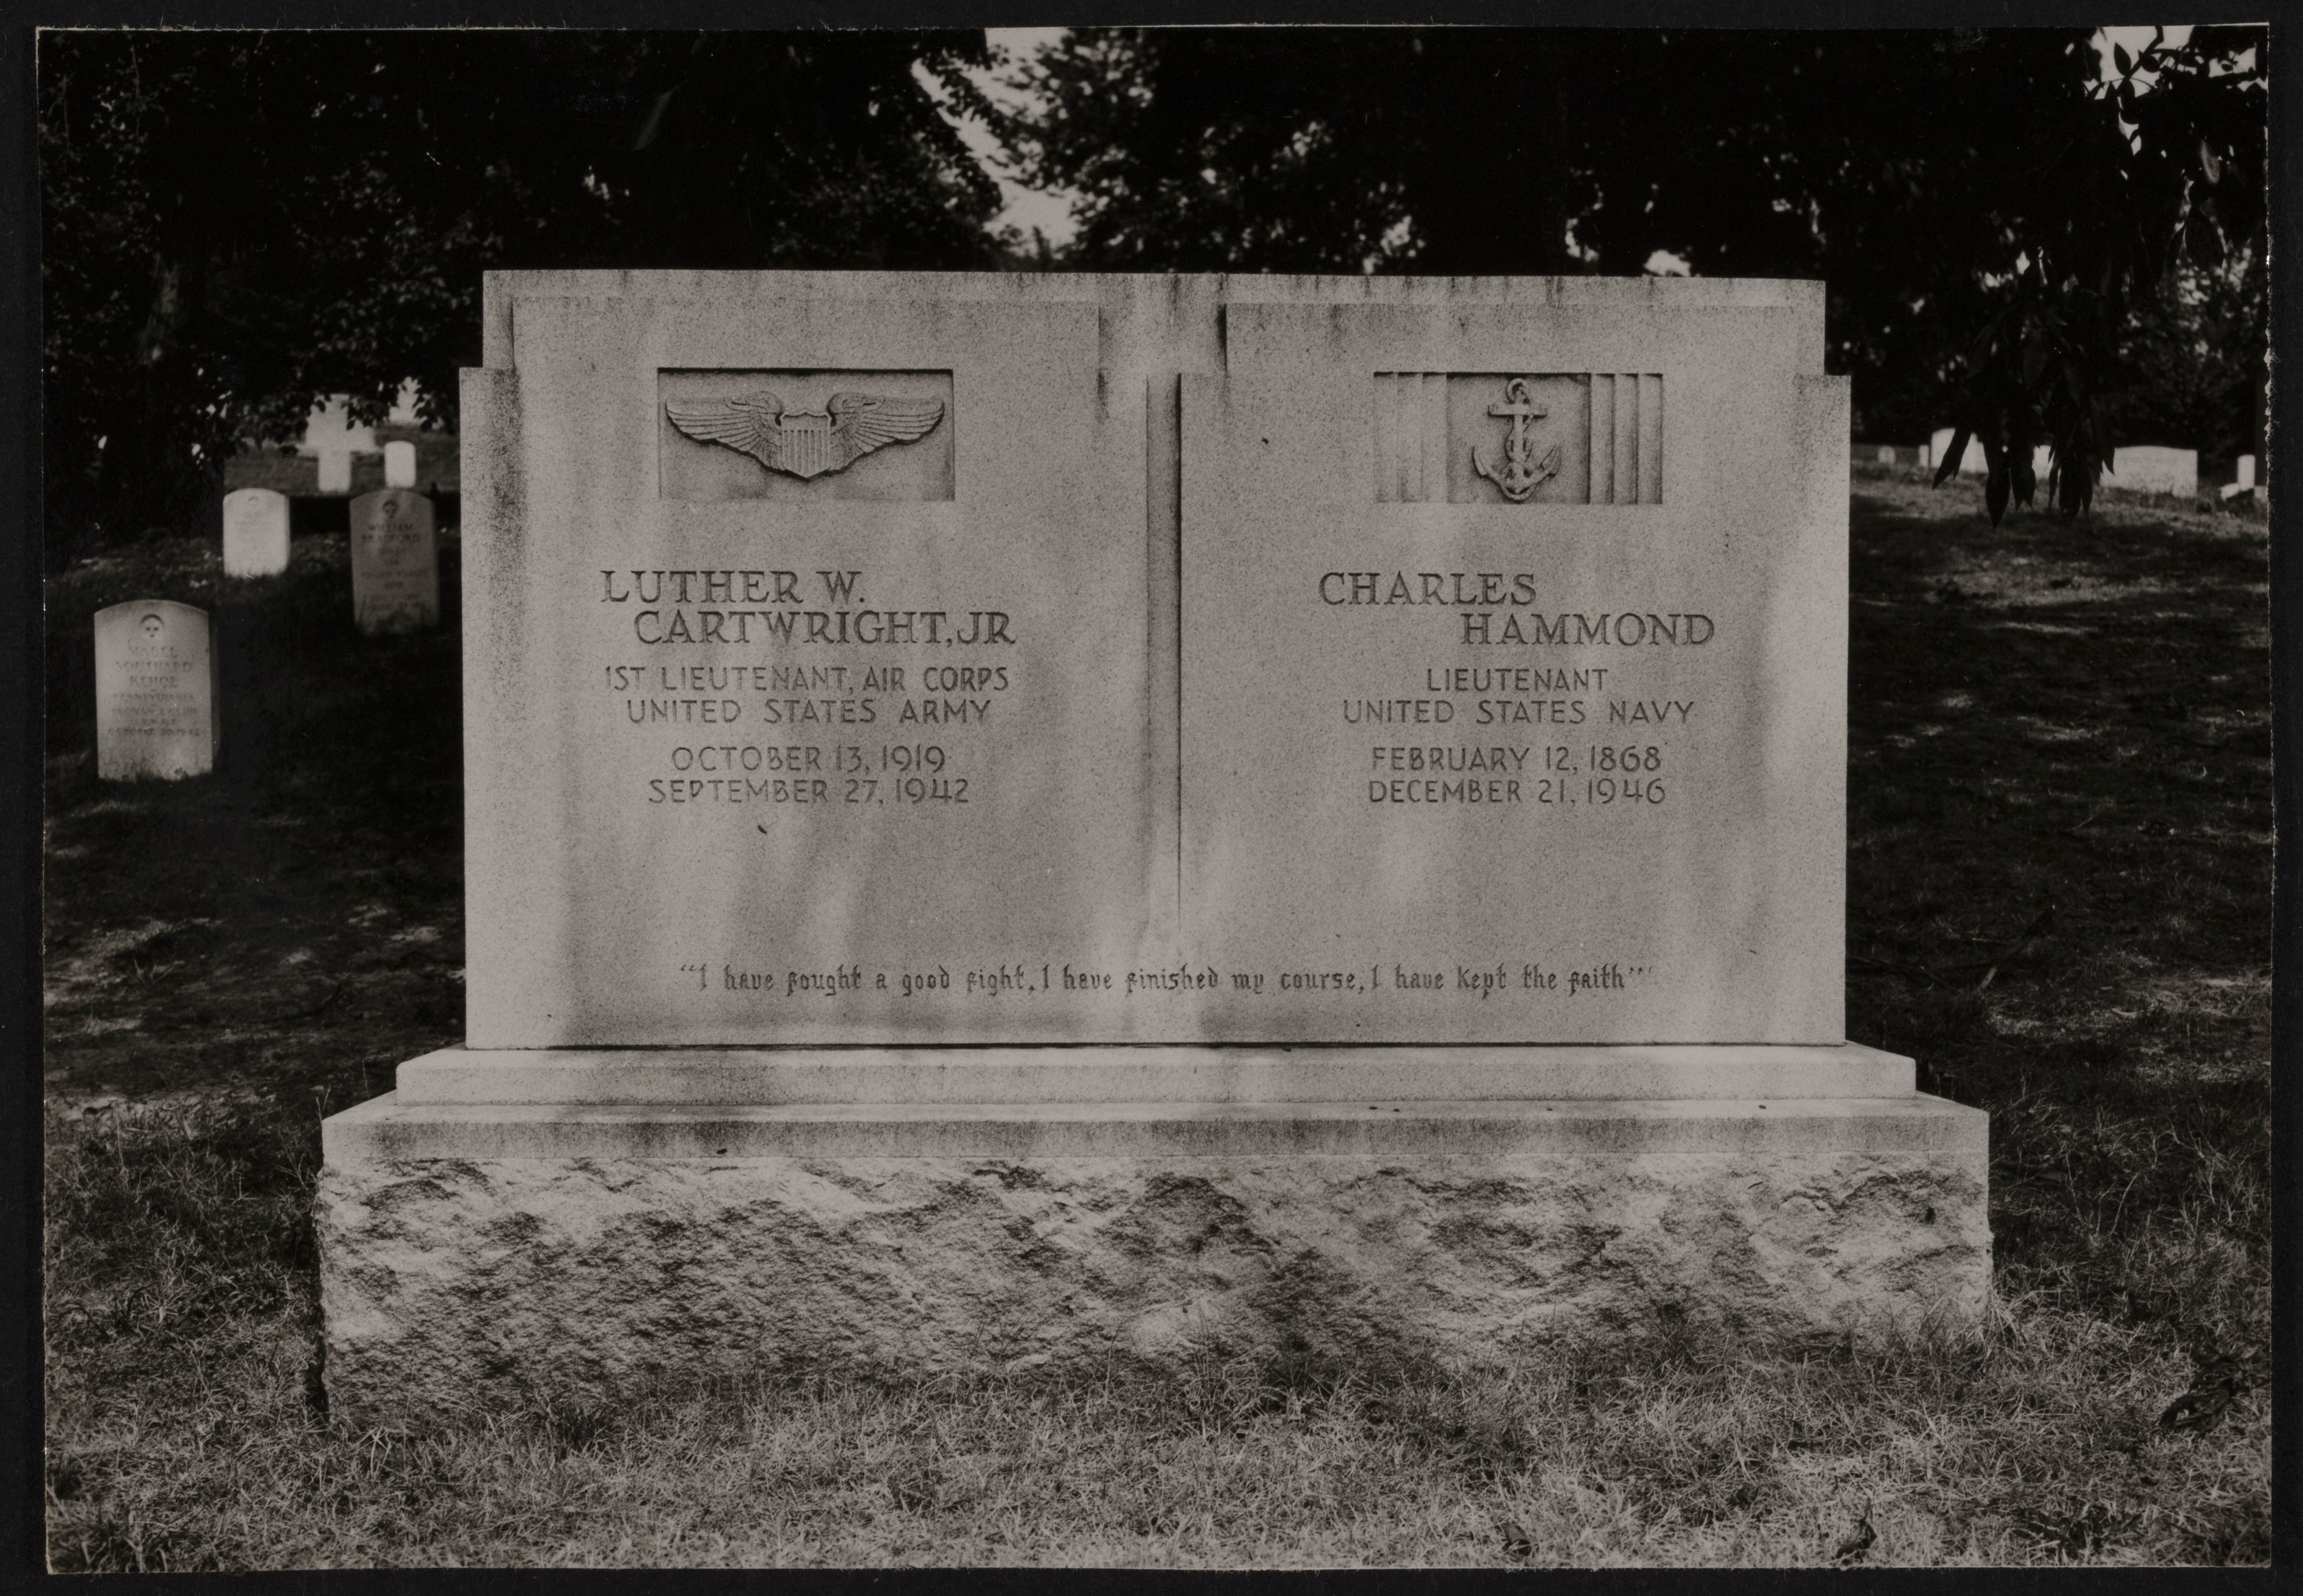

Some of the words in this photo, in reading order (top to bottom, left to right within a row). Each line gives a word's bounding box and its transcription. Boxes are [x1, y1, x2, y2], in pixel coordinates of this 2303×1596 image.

[600, 570, 804, 604] LUTHER
[816, 570, 865, 605] W.
[1318, 570, 1537, 607] CHARLES
[1460, 612, 1715, 647] HAMMOND
[606, 665, 646, 692] 1ST
[661, 665, 853, 695] LIEUTENANT,
[863, 666, 905, 692] AIR
[924, 666, 1008, 692] CORPS
[1427, 668, 1608, 693] LIEUTENANT
[627, 698, 741, 724] UNITED
[764, 698, 876, 724] STATES
[899, 699, 991, 724] ARMY
[1344, 699, 1454, 724] UNITED
[1476, 699, 1585, 725] STATES
[1610, 700, 1695, 725] NAVY
[672, 745, 821, 772] OCTOBER
[836, 745, 870, 775] 13,
[882, 744, 945, 774] 1919
[1372, 746, 1530, 772] FEBRUARY
[1546, 746, 1578, 775] 12,
[1591, 745, 1662, 773] 1868
[648, 778, 829, 804] SEPTEMBER
[845, 778, 883, 805] 27,
[896, 778, 968, 805] 1942
[1368, 779, 1521, 804] DECEMBER
[1538, 779, 1576, 807] 21,
[1588, 778, 1665, 805] 1946
[724, 964, 774, 991] have
[786, 964, 861, 998] fought
[876, 973, 887, 990] a
[902, 964, 950, 998] good
[1062, 964, 1112, 990] have
[1125, 963, 1218, 997] finished
[1231, 973, 1264, 994] my
[1395, 964, 1444, 990] have
[1522, 964, 1557, 990] the
